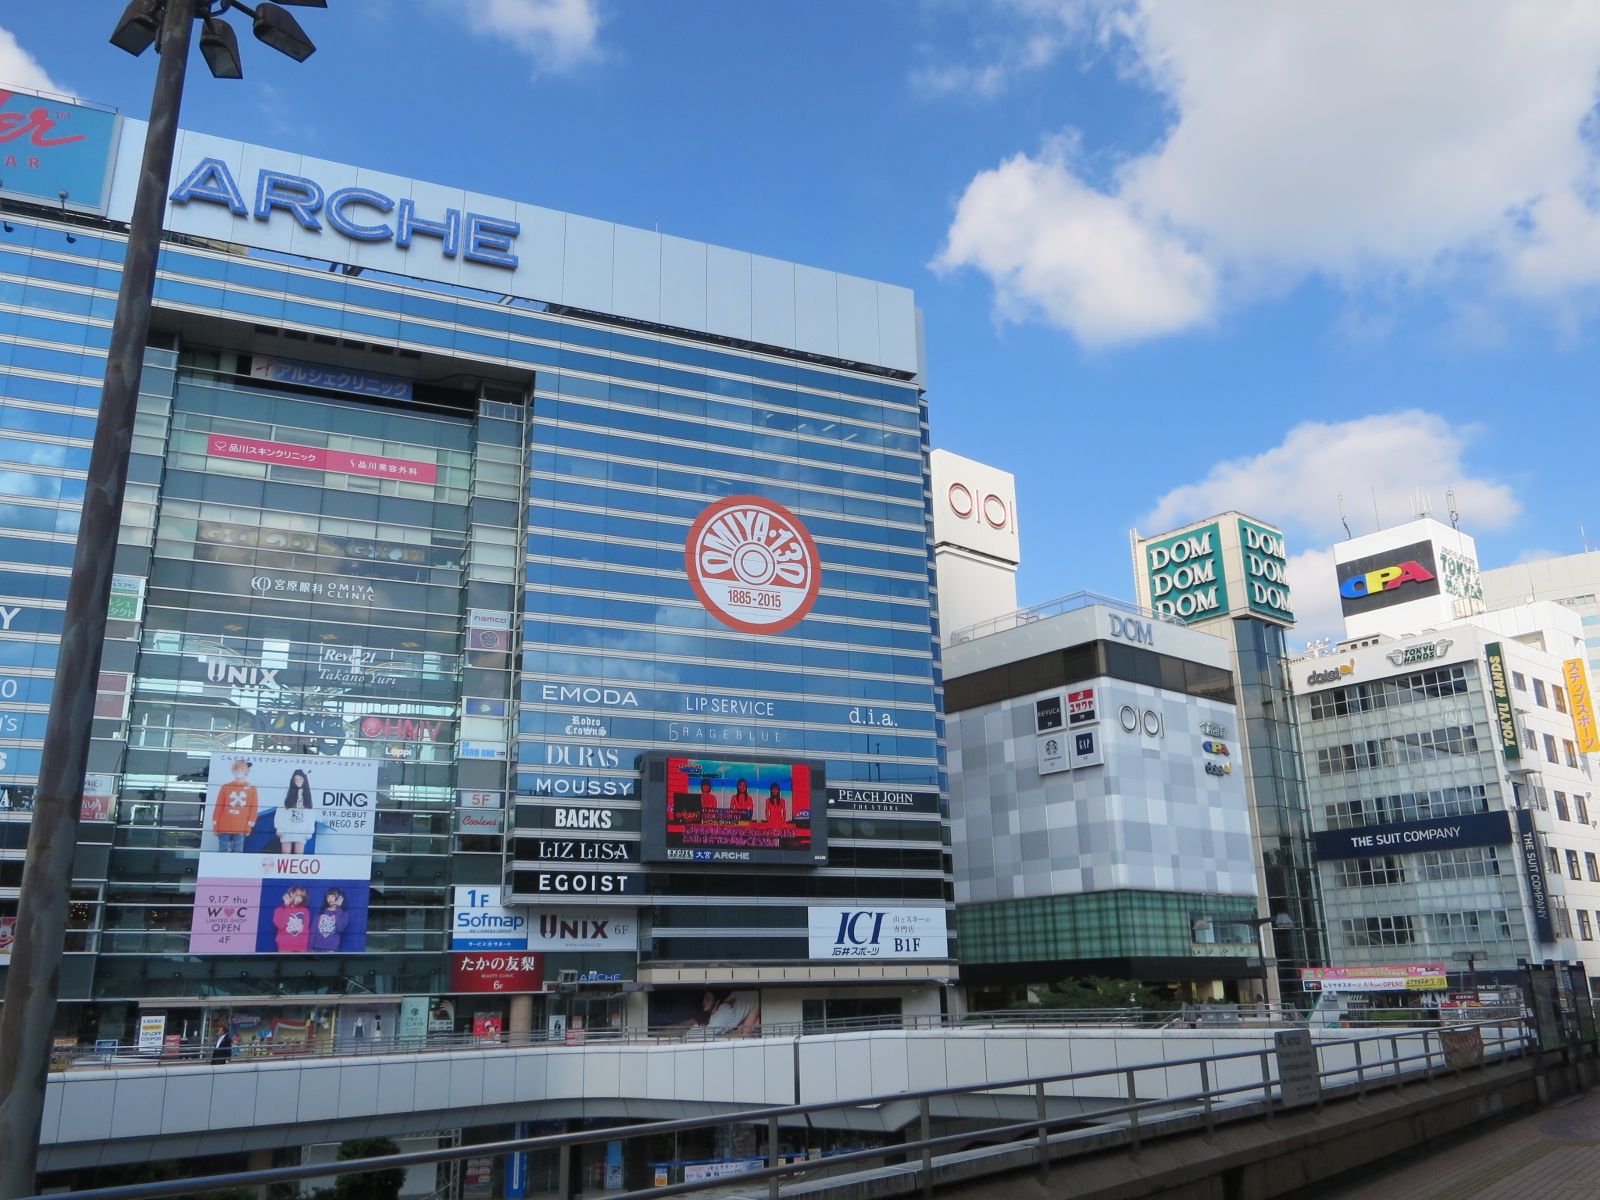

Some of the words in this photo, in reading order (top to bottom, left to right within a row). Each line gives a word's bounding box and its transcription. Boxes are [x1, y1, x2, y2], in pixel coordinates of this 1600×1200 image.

[169, 157, 520, 270] ARCHE
[277, 362, 408, 397] アルシェクリニック
[228, 443, 316, 463] 品川スキンクリニック
[1150, 530, 1213, 571] DOM
[1244, 526, 1286, 559] DOM
[1152, 558, 1216, 597] DOM
[1248, 552, 1289, 586] DOM
[274, 579, 323, 594] 宮原眼科
[327, 582, 374, 594] OMIYA
[1340, 560, 1435, 599] OPA
[327, 590, 376, 601] CLINIC
[1155, 585, 1220, 620] DOM
[1252, 580, 1293, 613] DOM
[474, 615, 508, 624] namco
[1108, 612, 1154, 646] DOM
[1403, 651, 1434, 664] HANDS
[1404, 644, 1435, 656] TOKYU
[207, 660, 280, 686] UNIX
[319, 668, 365, 682] Takano
[369, 673, 396, 685] Yuri
[1489, 655, 1509, 702] HANDS
[542, 685, 638, 706] EMODA
[686, 697, 708, 711] LIP
[711, 698, 775, 716] SERVICE
[1567, 661, 1595, 750] ステップスポーツ
[571, 715, 601, 726] Rodeo
[849, 707, 898, 726] d.i.a.
[1497, 702, 1514, 747] TOKYU
[547, 744, 619, 768] DURAS
[536, 778, 633, 796] MOUSSY
[838, 789, 880, 803] PEACH
[884, 792, 913, 803] JOHN
[322, 791, 368, 807] DING
[472, 794, 490, 805] 5F
[329, 819, 350, 828] WEGO
[354, 820, 366, 828] 5F
[462, 815, 497, 826] Coolens
[555, 808, 612, 829] BACKS
[1351, 836, 1373, 848] THE
[1376, 832, 1400, 845] SUIT
[1403, 826, 1461, 842] COMPANY
[1523, 832, 1534, 852] THE
[538, 841, 574, 858] LIZ
[580, 842, 629, 860] LISA
[696, 850, 712, 860] 大宮
[713, 852, 749, 860] ARCHE
[277, 859, 320, 874] WEGO
[1527, 854, 1539, 873] SUIT
[539, 874, 628, 892] EGOIST
[208, 895, 230, 905] 9.17
[233, 896, 248, 904] thu
[467, 889, 490, 908] 1F
[1530, 873, 1548, 919] COMPANY
[211, 924, 241, 932] OPEN
[457, 912, 524, 930] Sofmap
[539, 914, 609, 939] UNIX
[614, 924, 630, 935] 6F
[834, 911, 889, 944] ICI
[218, 936, 231, 944] 4F
[894, 938, 920, 952] B1F
[832, 947, 880, 956] 石井スポーツ
[461, 956, 535, 971] たかの友梨
[493, 981, 504, 989] 6F
[579, 973, 621, 982] ARCHE
